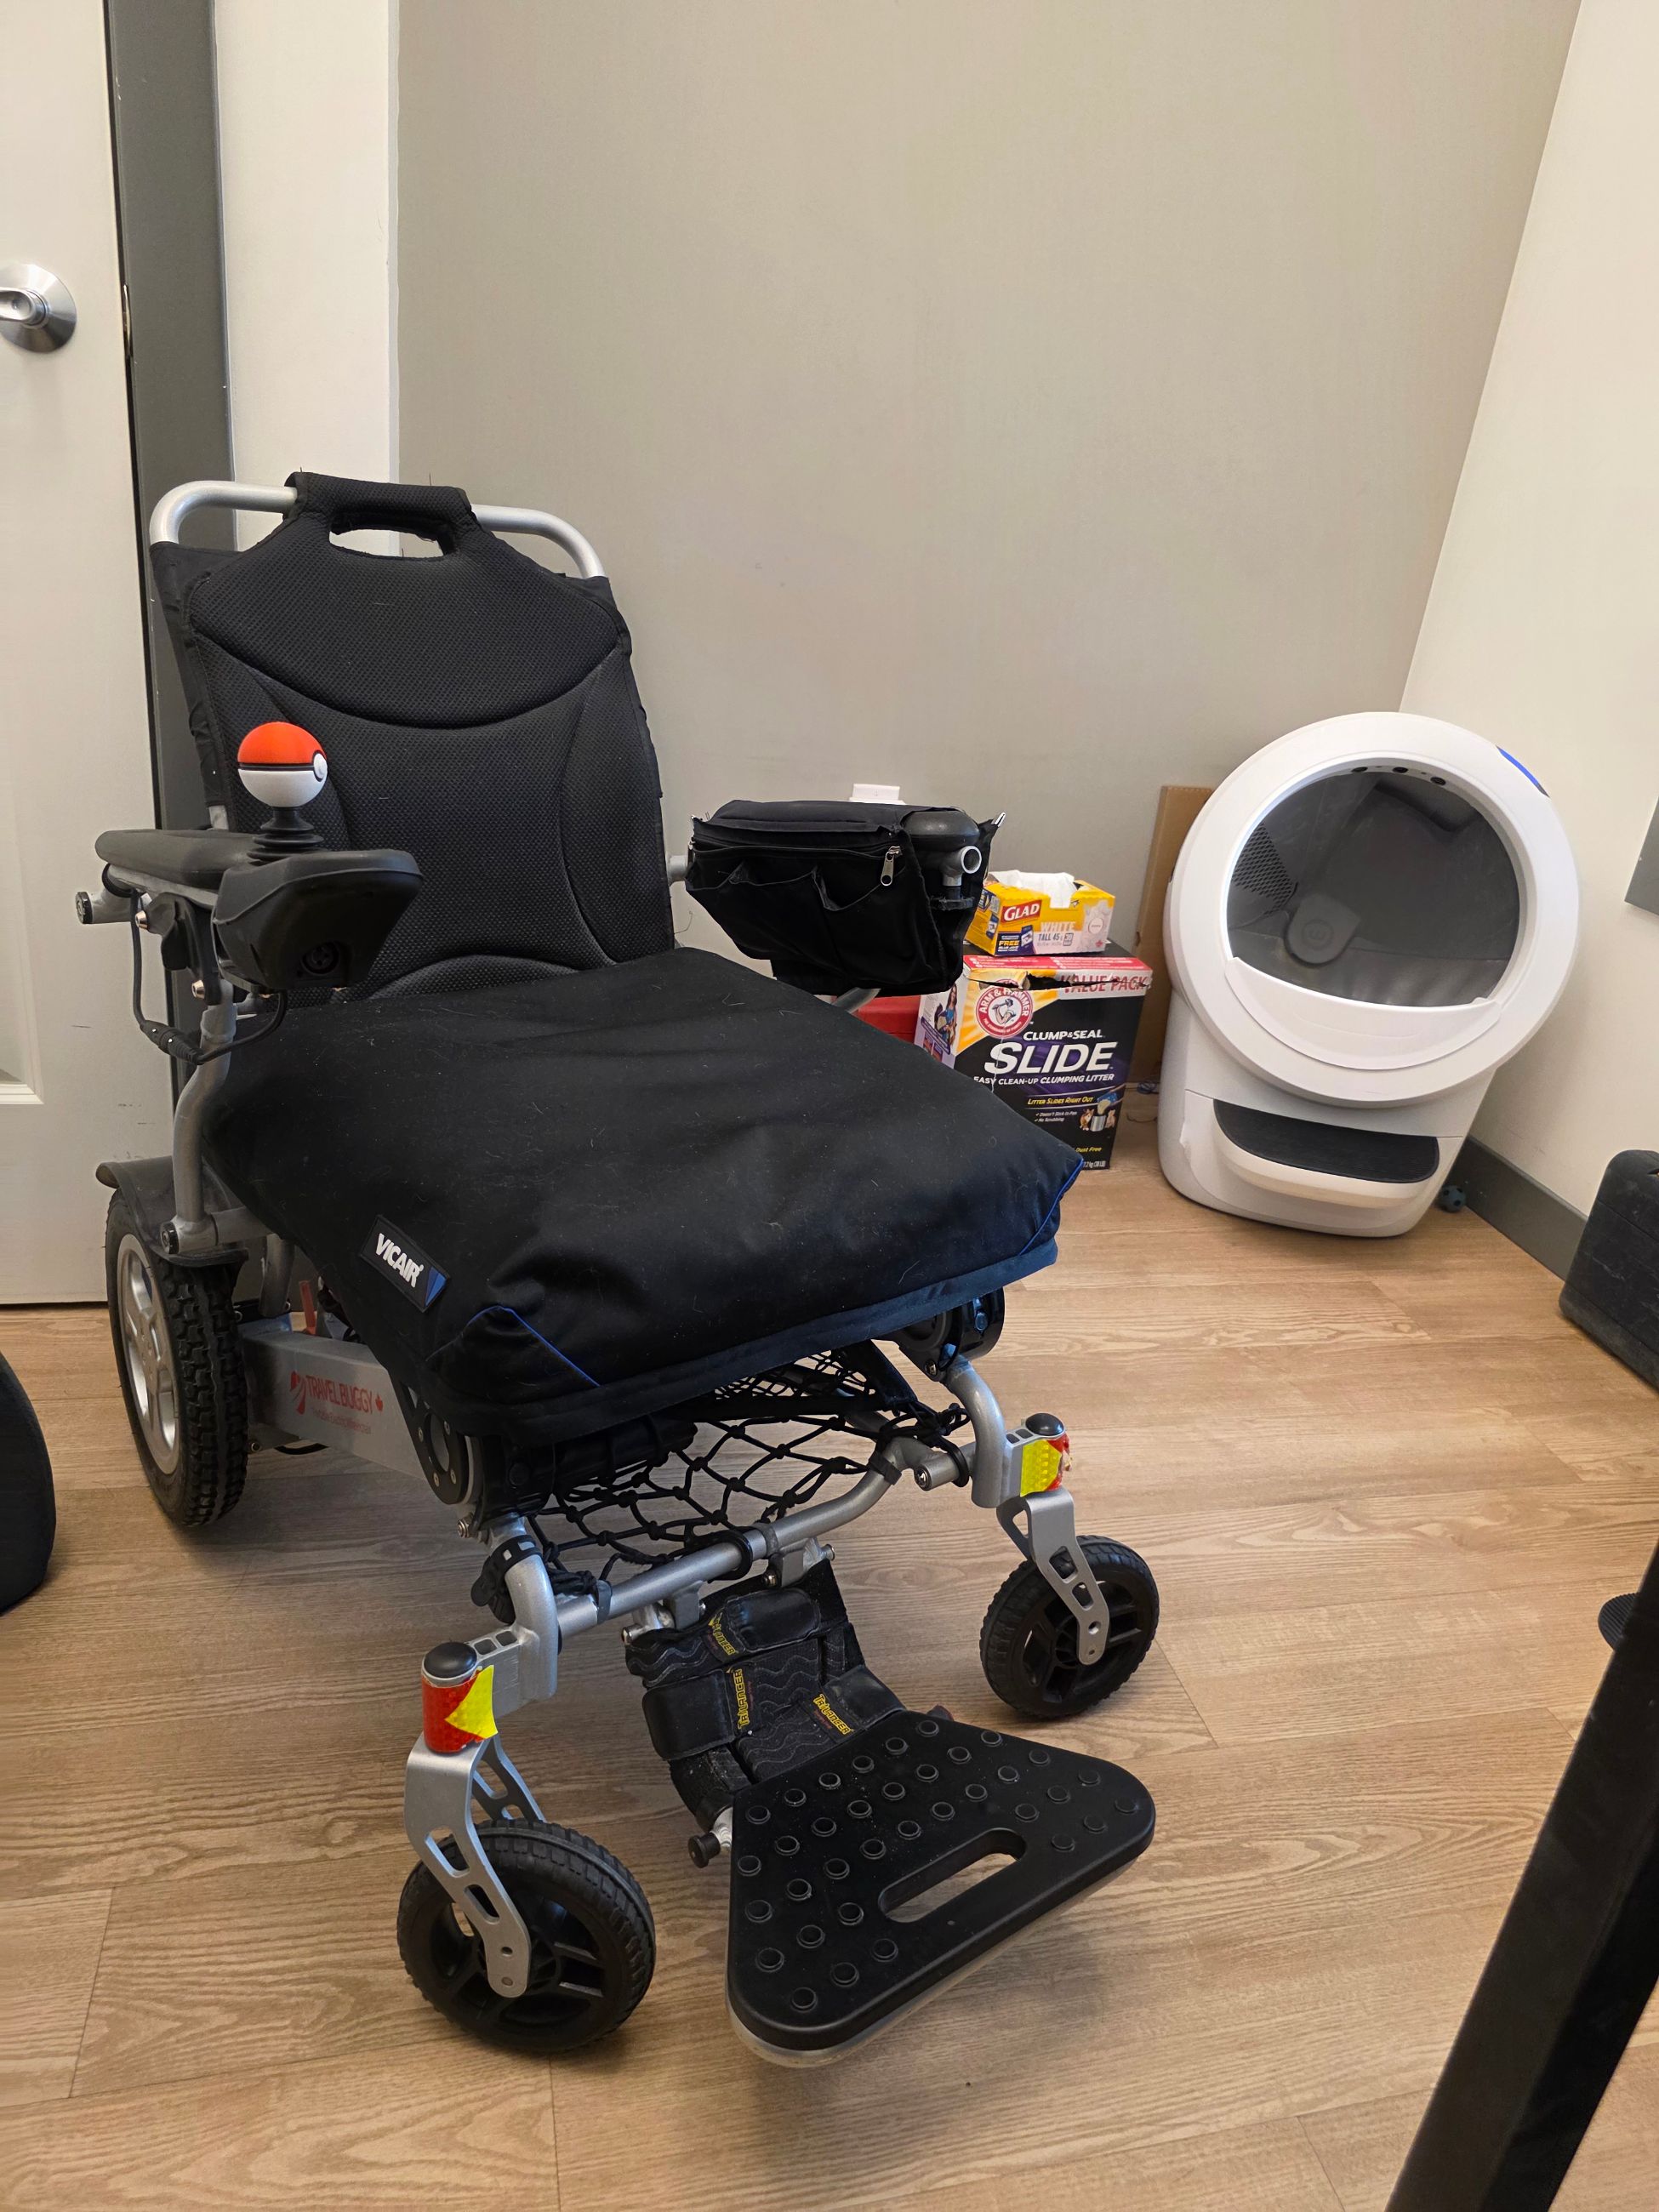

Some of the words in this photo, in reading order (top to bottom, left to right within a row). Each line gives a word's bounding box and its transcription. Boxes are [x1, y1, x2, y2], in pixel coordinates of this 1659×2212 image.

[1004, 904, 1040, 921] GLAD
[1040, 921, 1075, 932] WHITE
[1110, 974, 1148, 991] PACK
[979, 993, 995, 1013] ARM
[1023, 1029, 1103, 1040] CLUMP&SEAL
[983, 1041, 1118, 1075] SLIDE
[973, 1076, 996, 1085] EASY
[1040, 1075, 1085, 1084] CLUMPING
[375, 1233, 422, 1288] VICAIR
[305, 1374, 341, 1405] TRAVEL
[339, 1382, 373, 1414] BUGGY
